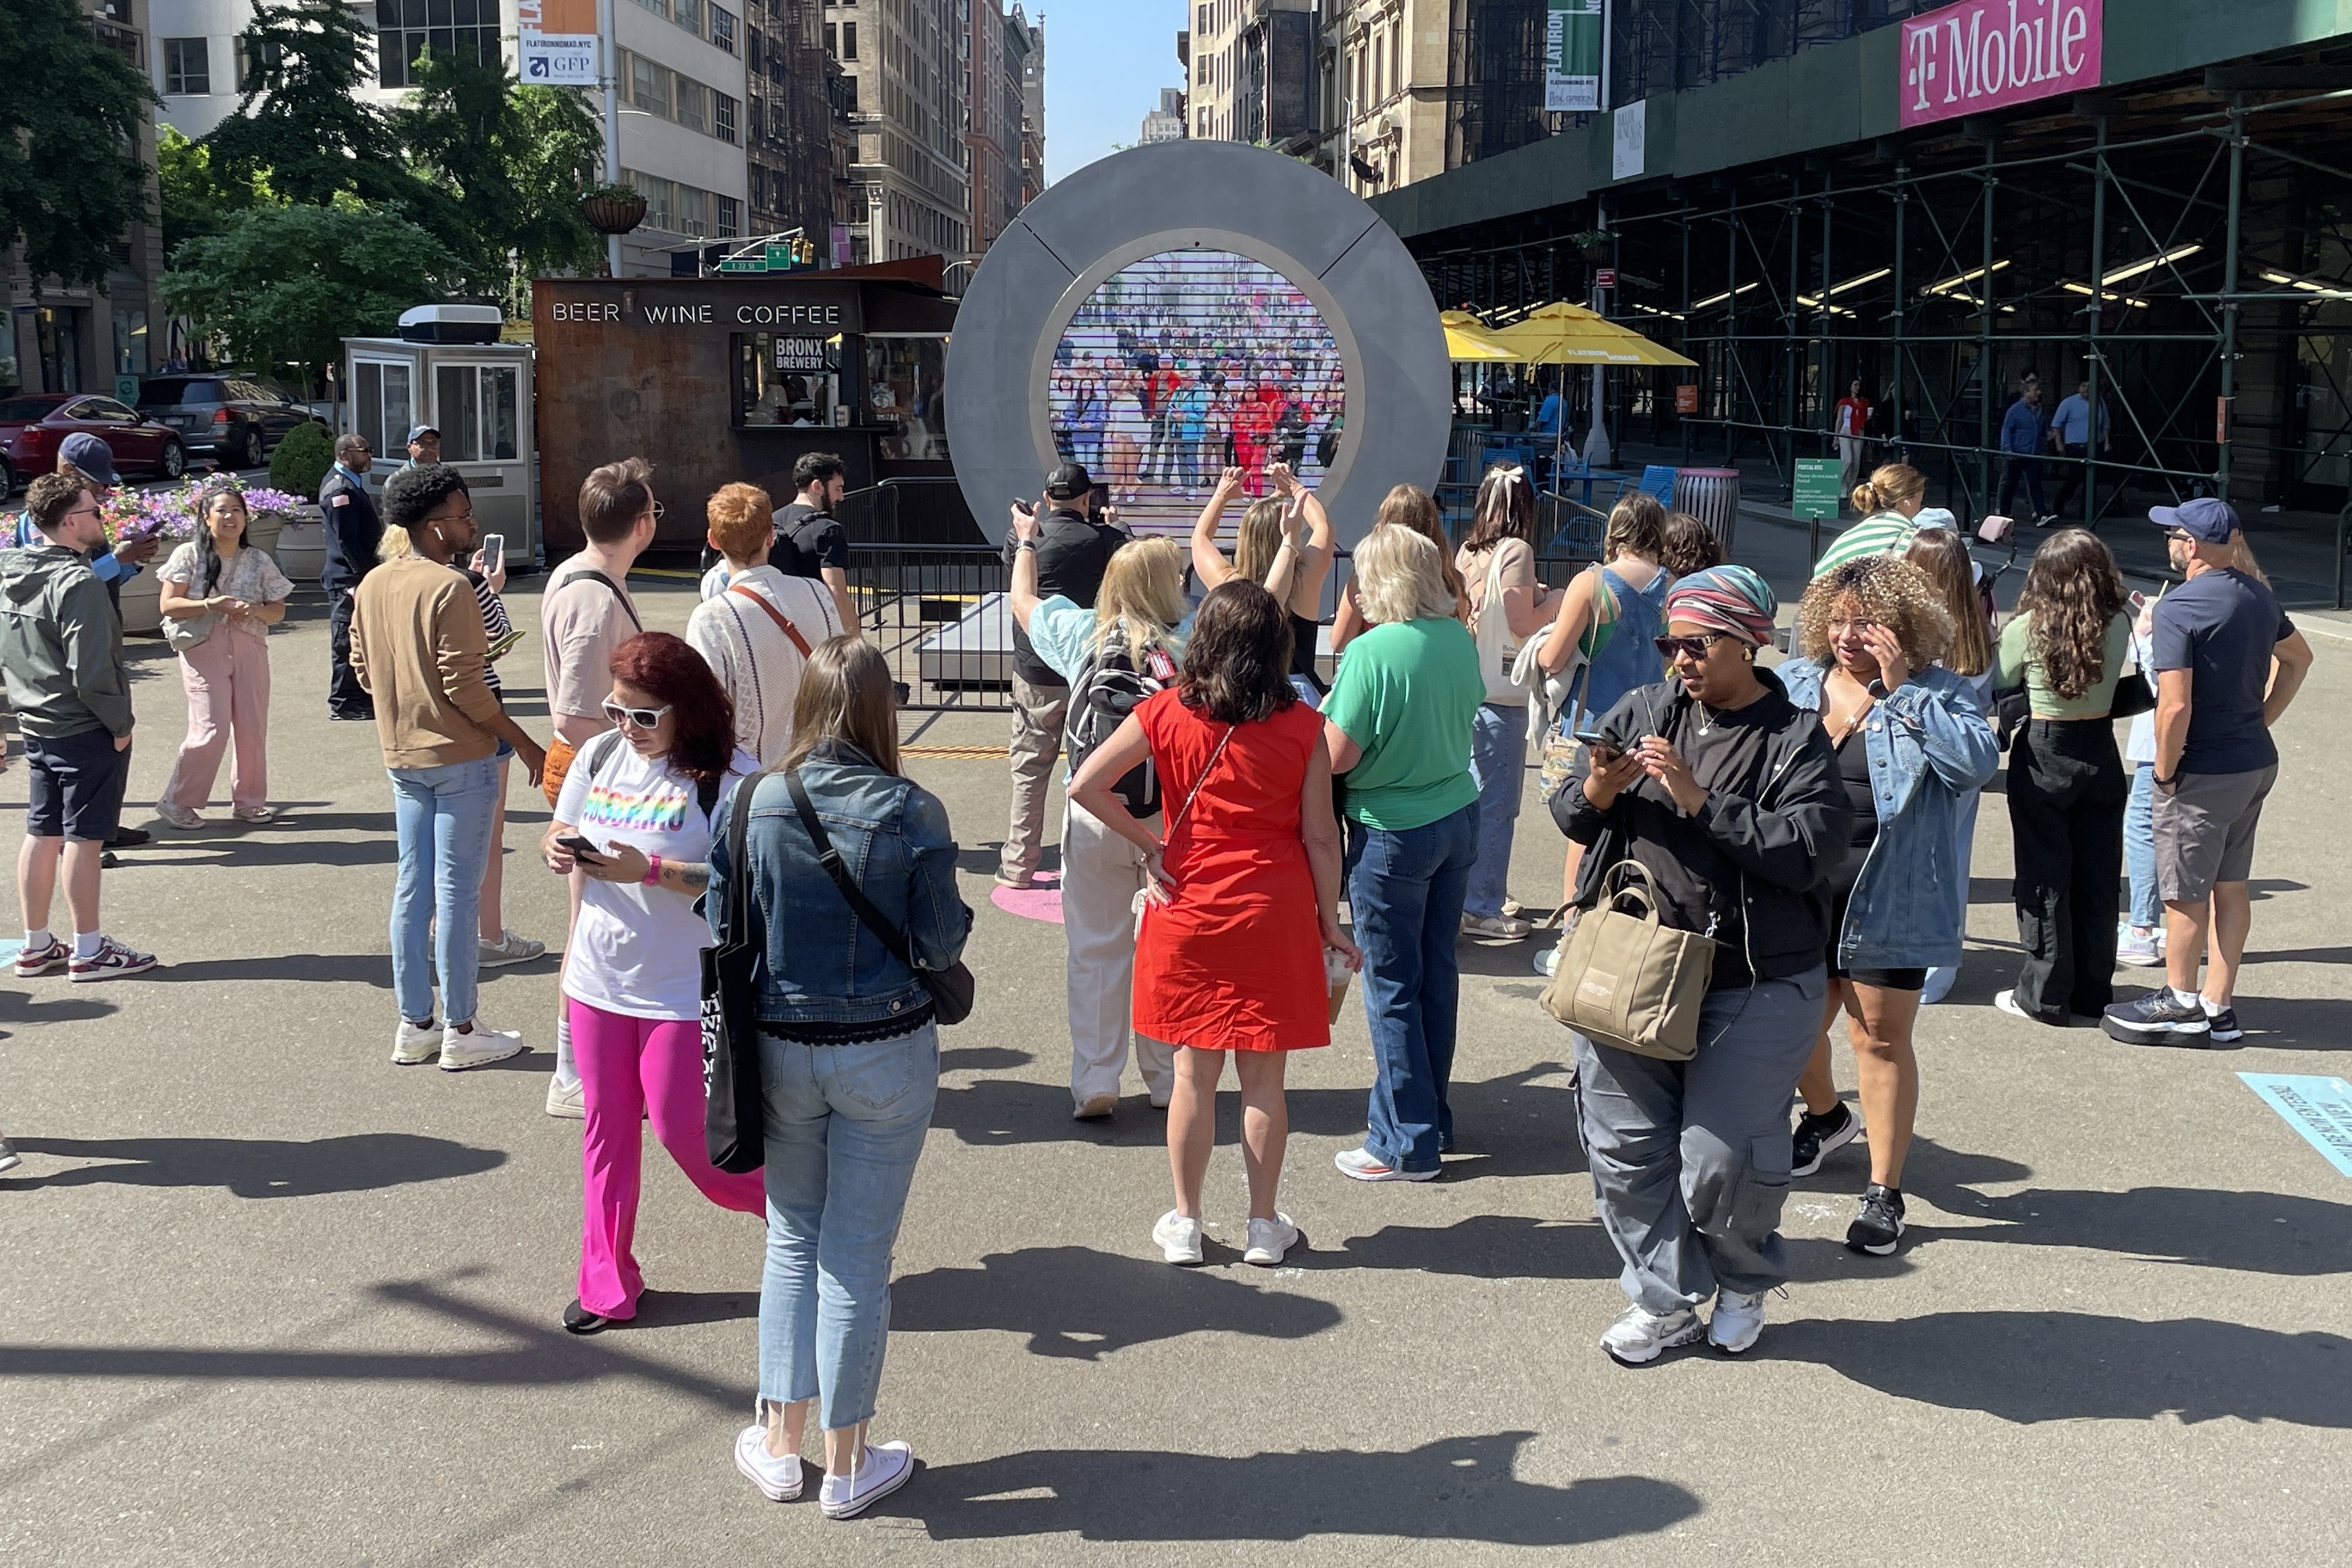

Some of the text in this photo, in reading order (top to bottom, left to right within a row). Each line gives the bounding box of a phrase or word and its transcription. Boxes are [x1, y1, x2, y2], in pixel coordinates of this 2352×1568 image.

[1547, 10, 1563, 75] FLATIRON
[1944, 0, 2087, 103] Mobile
[554, 57, 590, 71] GFP
[553, 303, 840, 324] BEER WINE COFFEE
[776, 339, 823, 356] BRONX
[776, 356, 823, 370] BREWERY
